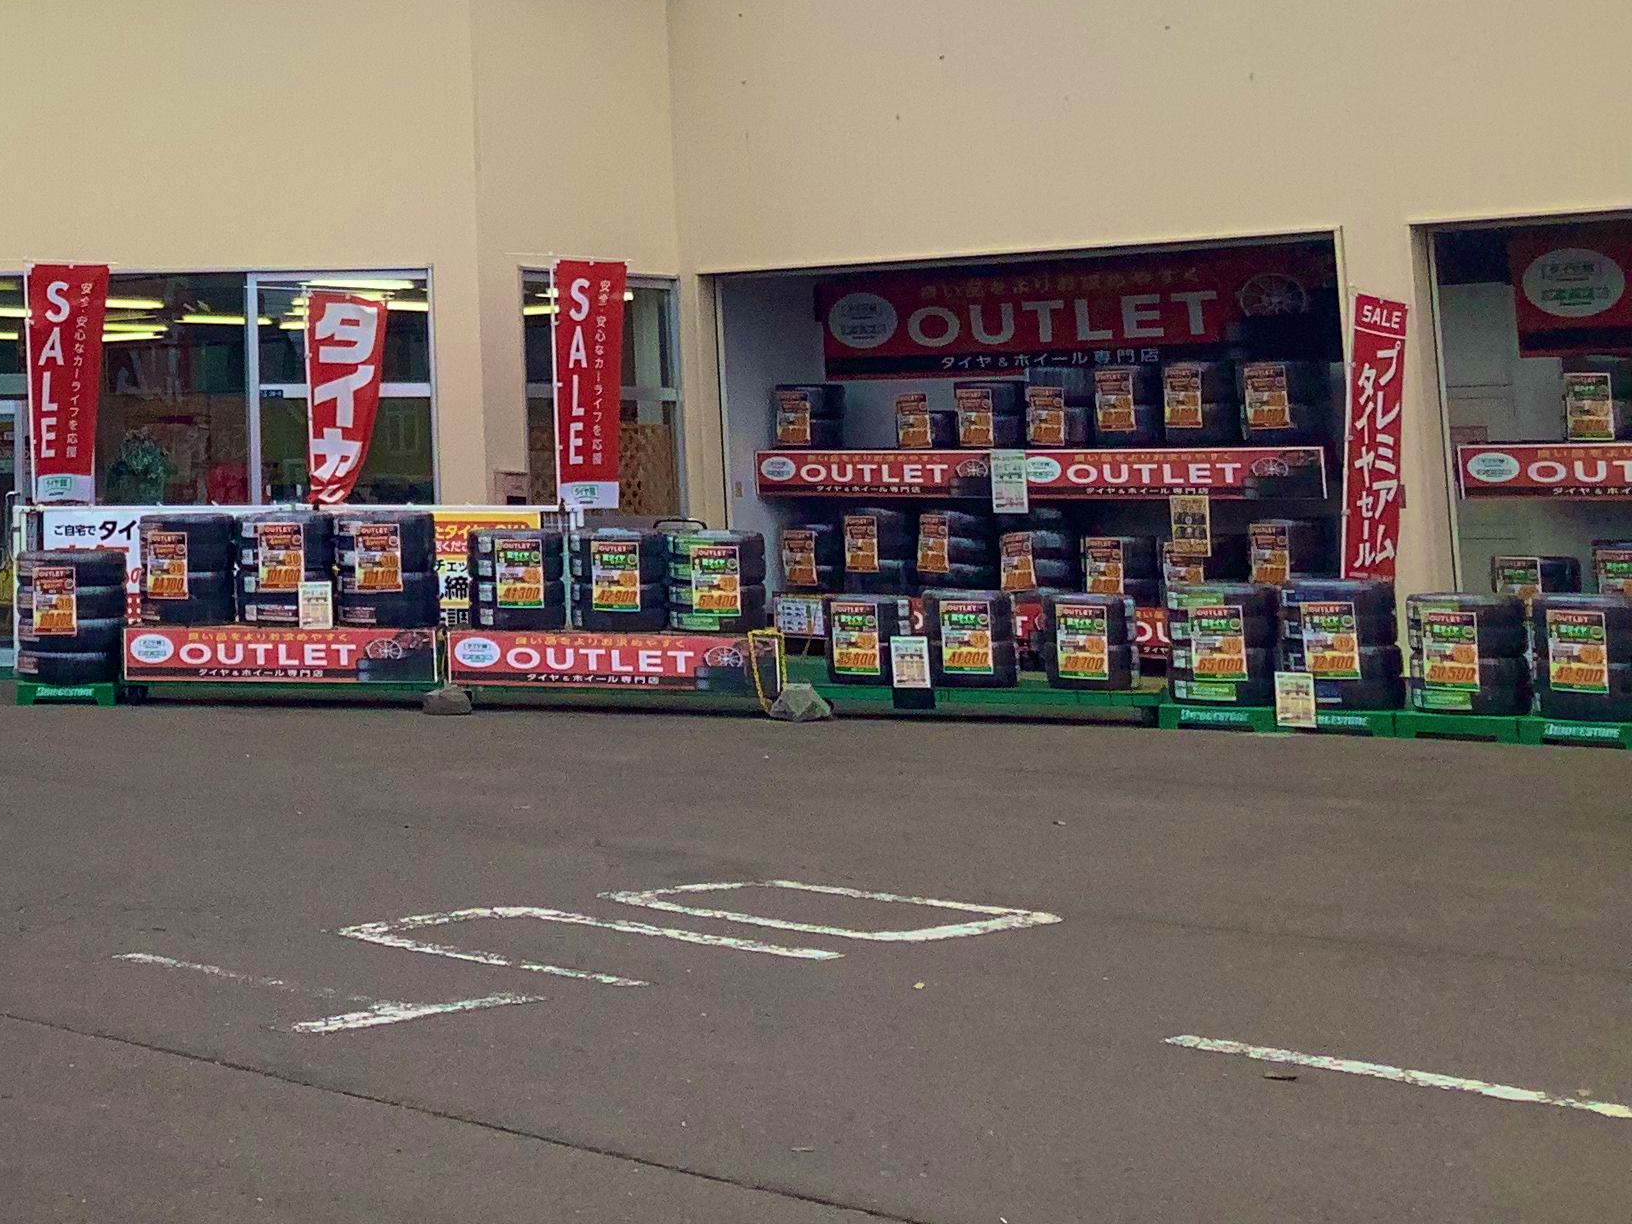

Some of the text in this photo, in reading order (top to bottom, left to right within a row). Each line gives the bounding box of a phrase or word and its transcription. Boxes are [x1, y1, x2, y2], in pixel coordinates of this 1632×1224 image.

[908, 290, 1217, 347] OUTLET
[1361, 305, 1402, 329] SALE
[38, 281, 70, 458] SALE
[569, 278, 590, 465] SALE
[1353, 363, 1375, 568] タイヤセール
[1373, 341, 1401, 564] プレミアム
[800, 463, 949, 484] OUTLET
[1067, 463, 1242, 484] OUTLET
[54, 520, 141, 541] ご自宅でタイ
[179, 643, 356, 666] OUTLET
[506, 647, 695, 674] OUTLET
